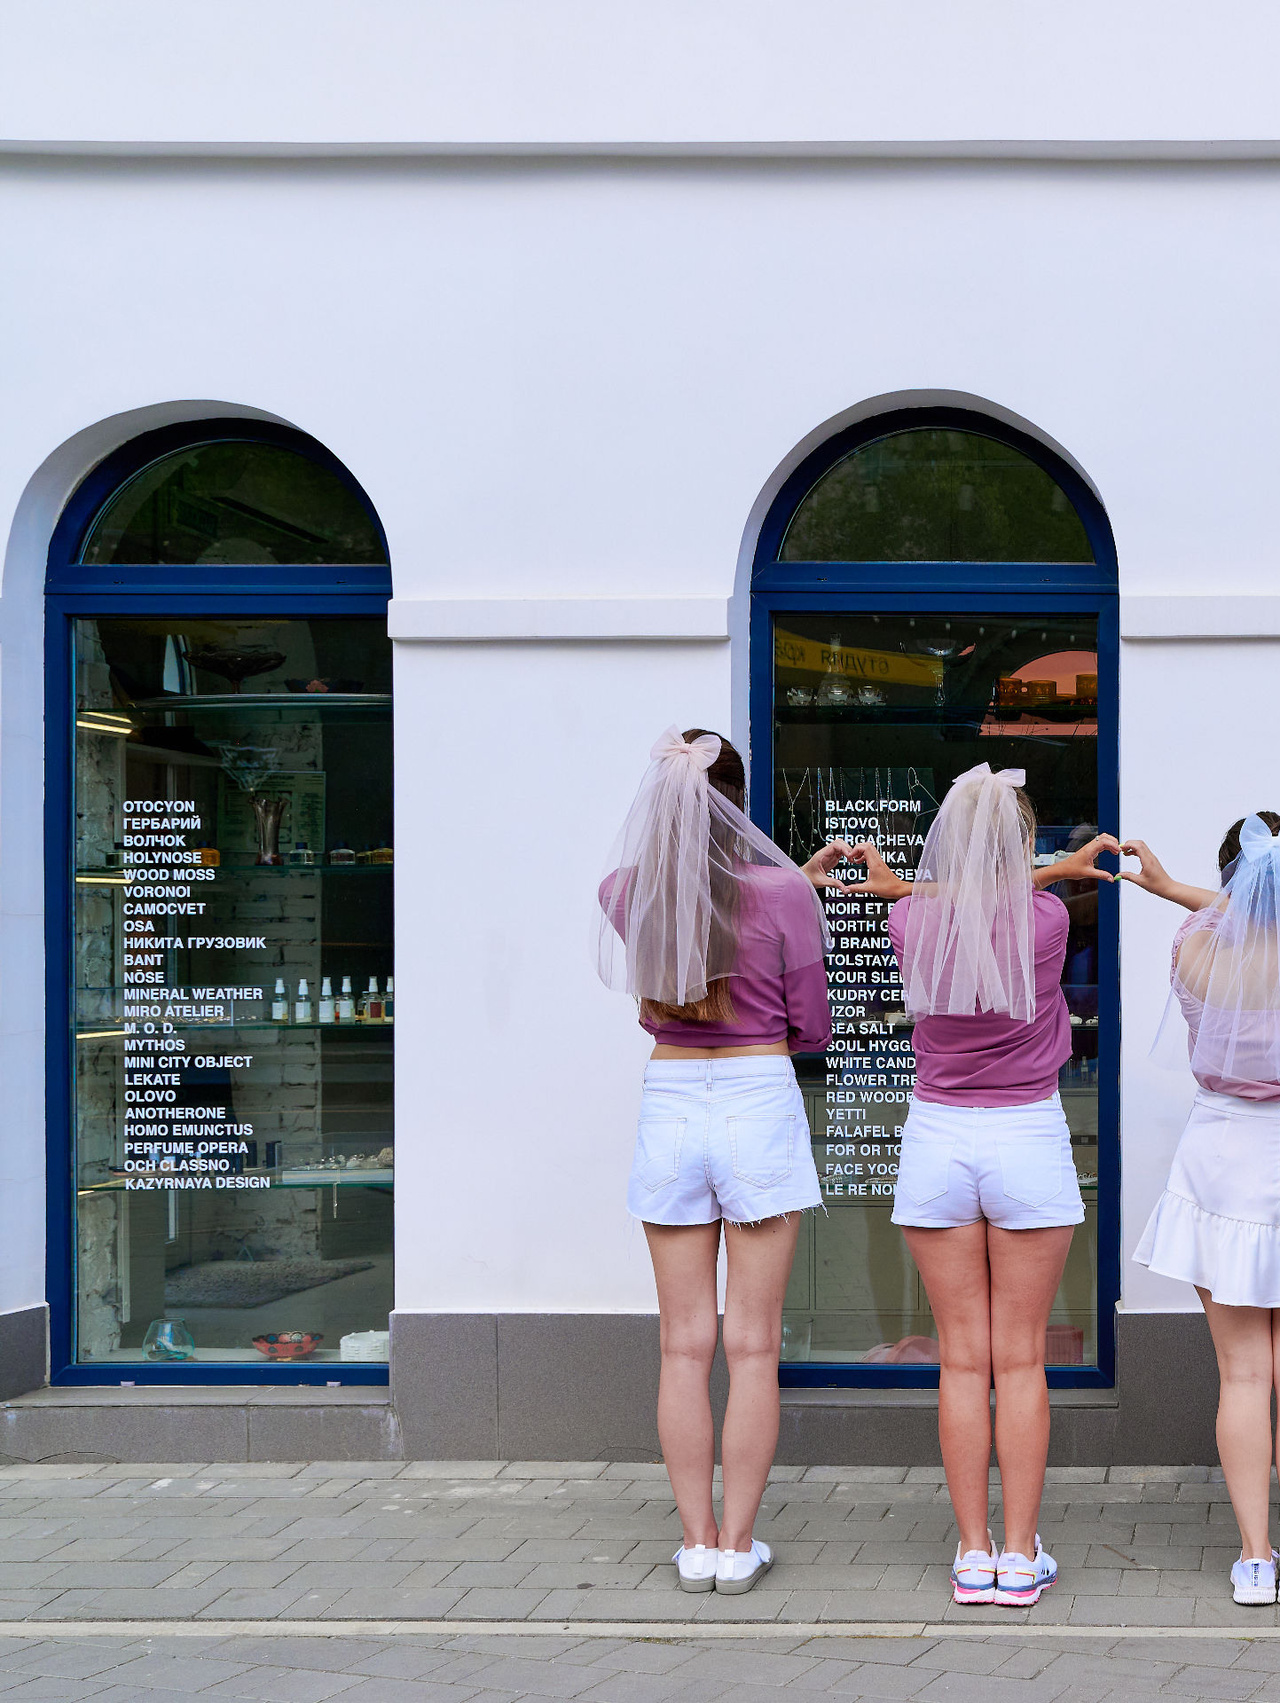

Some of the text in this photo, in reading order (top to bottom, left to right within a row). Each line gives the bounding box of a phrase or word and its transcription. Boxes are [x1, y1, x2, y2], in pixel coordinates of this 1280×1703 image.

[123, 801, 195, 812] OTOCYON
[123, 815, 201, 830] ГЕРБАРИЙ
[826, 817, 878, 828] ISTOVO
[123, 835, 185, 847] ВОЛЧОК
[123, 852, 202, 863] HOLYNOSE
[123, 869, 215, 880] WOOD MOSS
[124, 886, 191, 897] VORONOI
[124, 903, 206, 915] CAMOCVET
[826, 903, 860, 914] NOIR
[866, 903, 883, 914] ET
[124, 920, 154, 932] OSA
[826, 921, 875, 932] NORTH
[124, 937, 266, 949] НИКИТА ГРУЗОВИК
[841, 938, 890, 949] BRAND
[124, 955, 163, 966] BANT
[826, 955, 898, 966] TOLSTAYA
[826, 972, 866, 983] YOUR
[124, 988, 263, 1000] MINERAL WEATHER
[827, 990, 877, 1001] KUDRY
[124, 1005, 224, 1017] MIRO ATELIER
[124, 1022, 177, 1034] M. O. D.
[832, 1023, 895, 1034] SEA SALT
[124, 1040, 185, 1051] MYTHOS
[826, 1040, 914, 1051] SOUL HYGG
[124, 1057, 252, 1068] MINI CITY OBJECT
[826, 1057, 871, 1068] WHITE
[125, 1074, 180, 1085] LEKATE
[826, 1074, 886, 1085] FLOWER
[125, 1091, 176, 1102] OLOVO
[826, 1092, 855, 1103] RED
[125, 1107, 226, 1119] ANOTHERONE
[826, 1109, 866, 1120] YETTI
[124, 1125, 253, 1136] HOMO EMUNCTUS
[826, 1126, 890, 1137] FALAFEL
[124, 1142, 248, 1154] PERFUME OPERA
[826, 1145, 855, 1156] FOR
[860, 1145, 880, 1156] OR
[124, 1159, 229, 1171] OCH CLASSNO
[826, 1164, 863, 1175] FACE
[125, 1177, 270, 1189] KAZYRNAYA DESIGN
[826, 1184, 843, 1195] LE
[848, 1184, 867, 1195] RE
